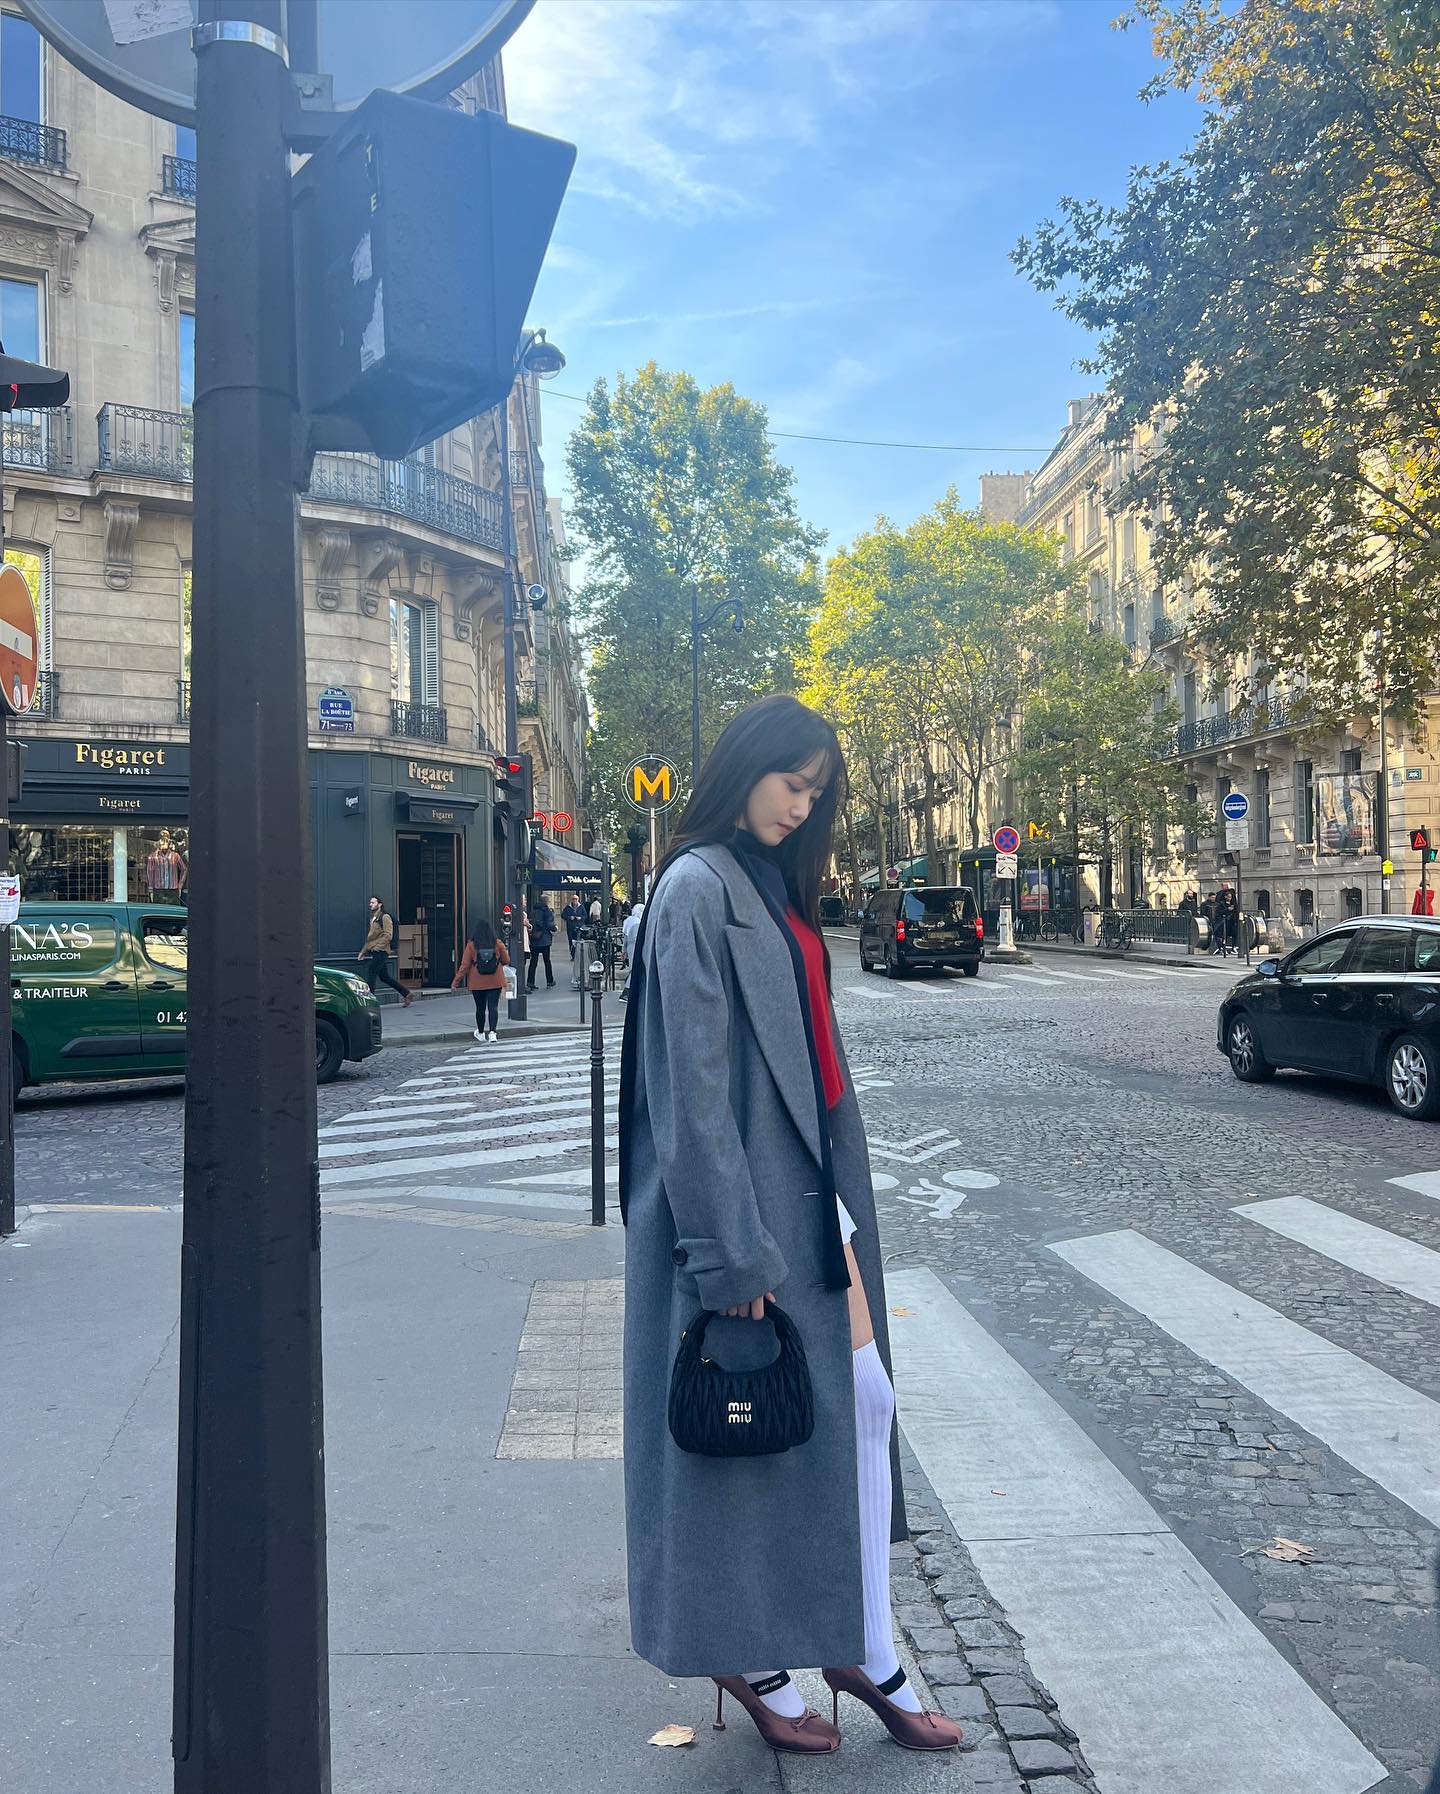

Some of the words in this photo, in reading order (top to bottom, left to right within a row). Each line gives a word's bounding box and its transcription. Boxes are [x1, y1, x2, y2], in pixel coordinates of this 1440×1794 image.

[321, 720, 330, 730] 71
[345, 723, 353, 731] 73
[75, 743, 166, 769] Figaret
[119, 767, 151, 775] PARIS
[408, 761, 454, 784] Figaret
[430, 783, 446, 791] PARIS
[633, 765, 670, 802] M
[99, 797, 141, 809] Figaret
[13, 988, 23, 1000] &
[24, 987, 89, 999] TRAITEUR
[157, 1011, 170, 1023] 01
